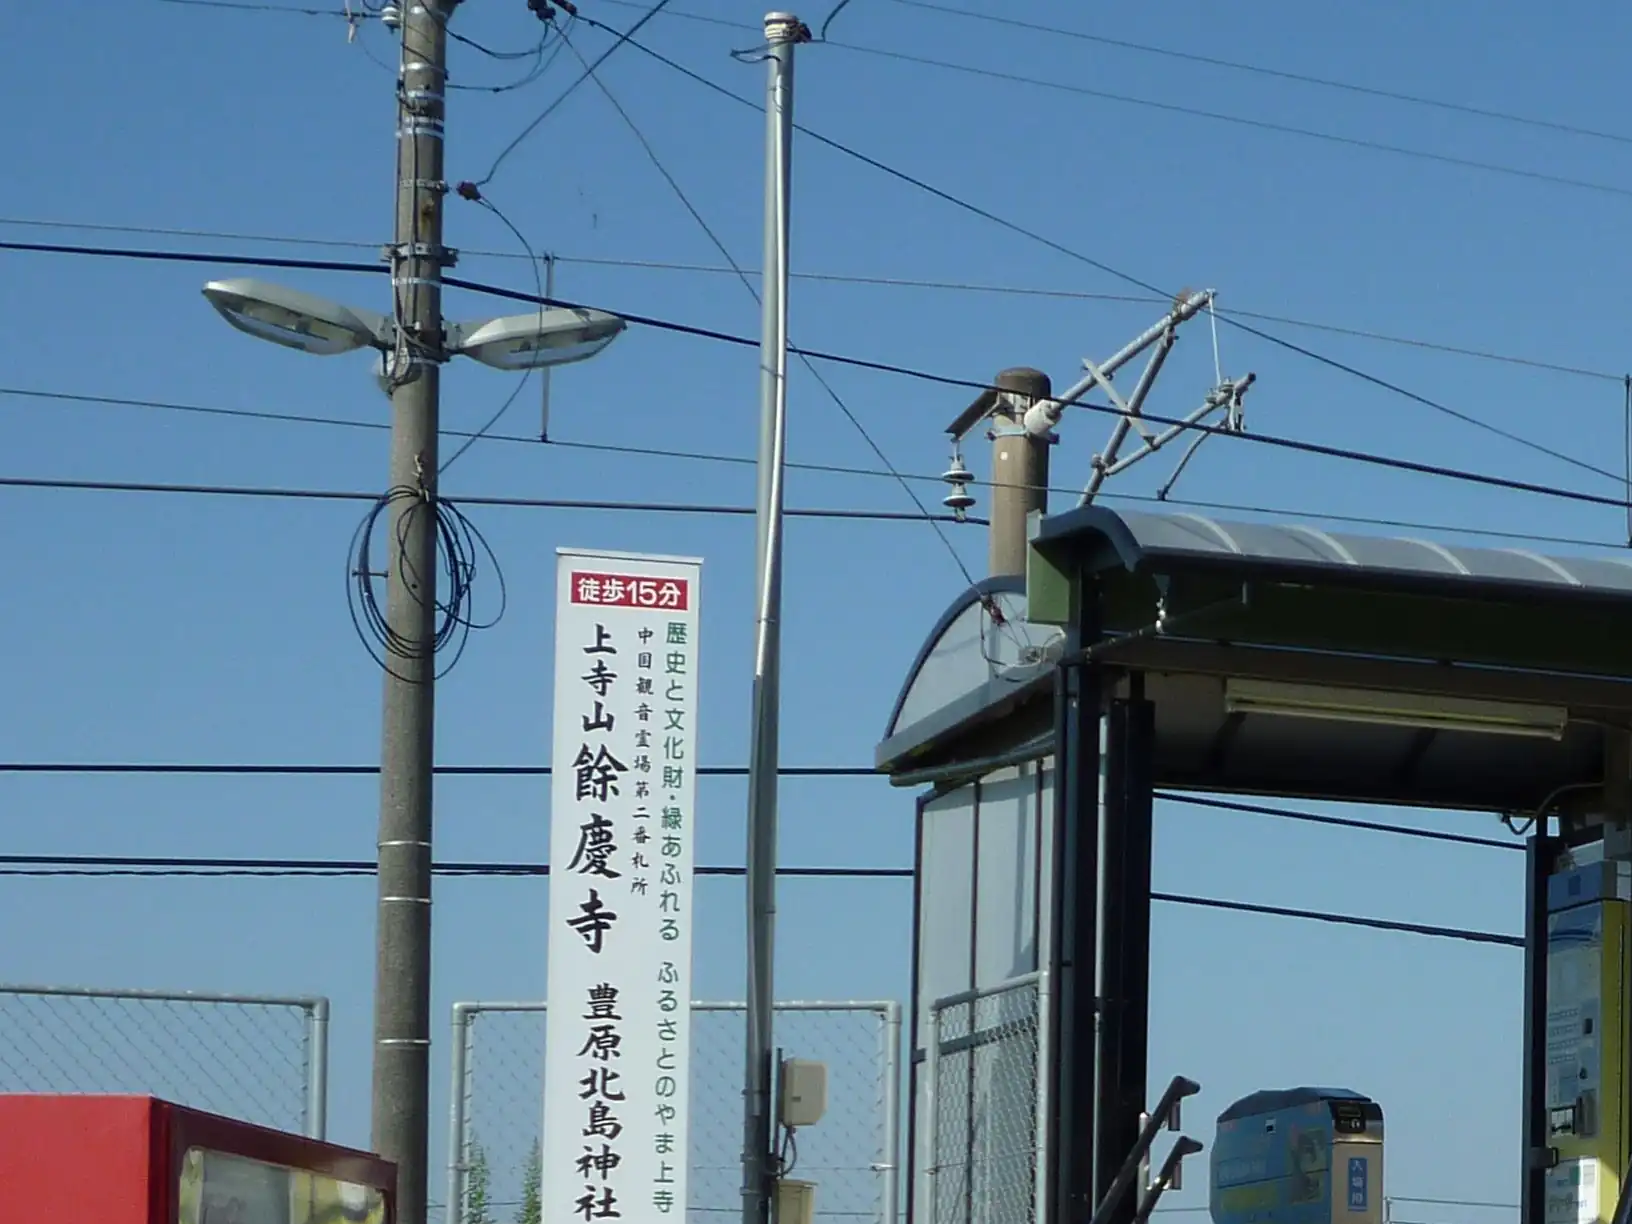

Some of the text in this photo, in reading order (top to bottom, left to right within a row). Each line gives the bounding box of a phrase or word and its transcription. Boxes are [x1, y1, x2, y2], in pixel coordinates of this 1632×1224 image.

[577, 577, 682, 607] 徒歩15分
[652, 621, 687, 1214] 歴史と文化財・緑あふれる ふるさとのやま上寺
[573, 982, 627, 1222] 豊原北島神社
